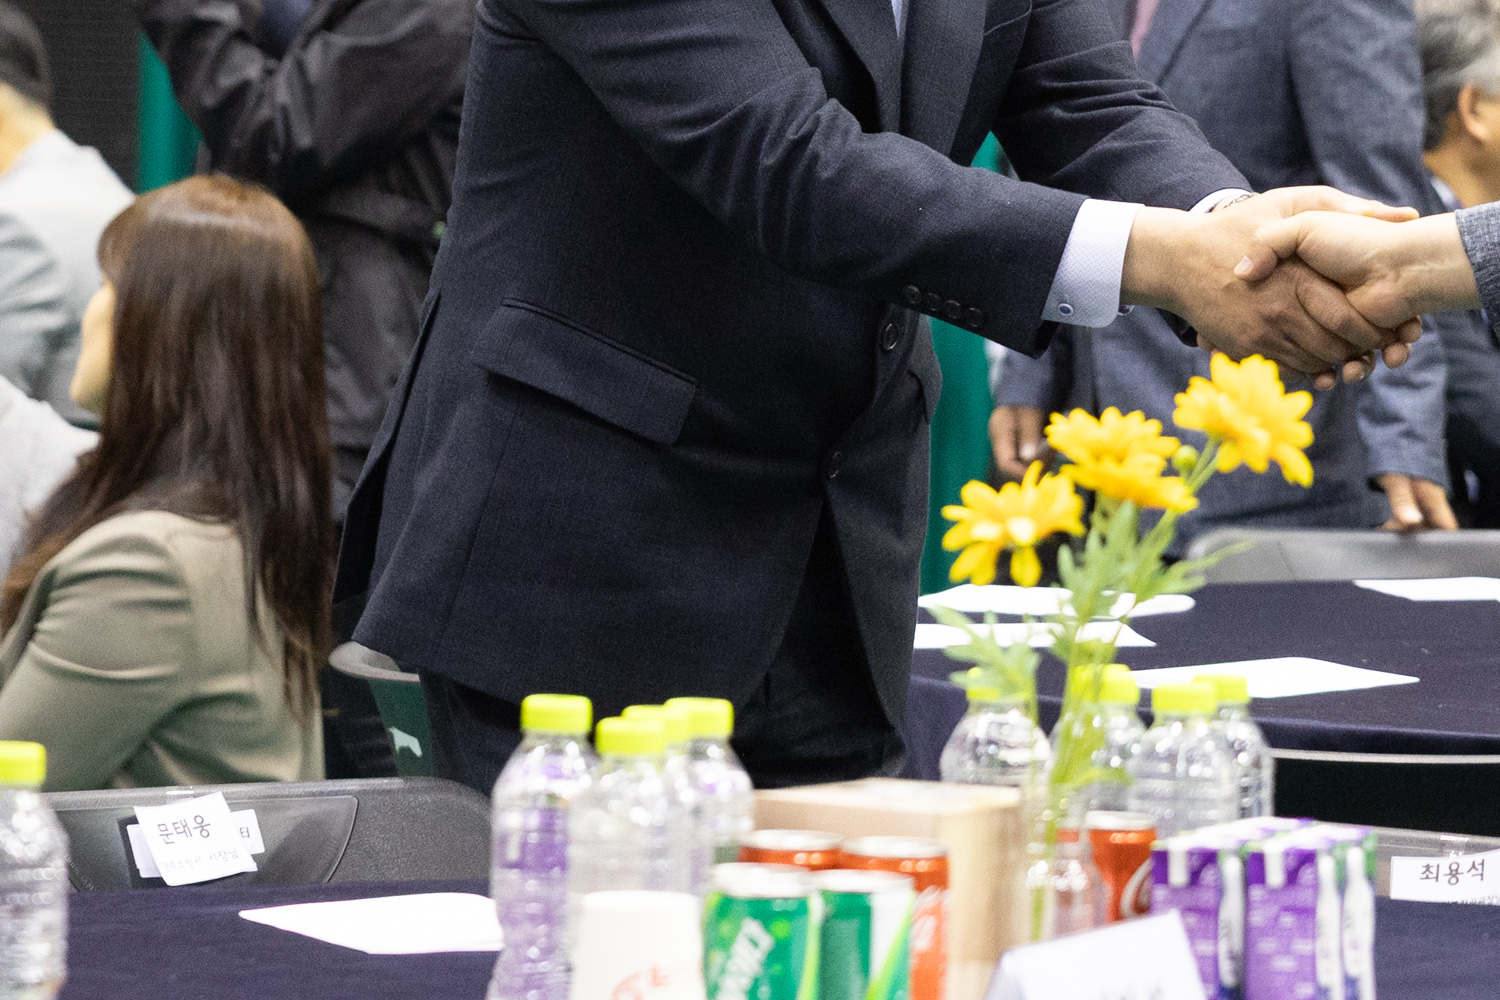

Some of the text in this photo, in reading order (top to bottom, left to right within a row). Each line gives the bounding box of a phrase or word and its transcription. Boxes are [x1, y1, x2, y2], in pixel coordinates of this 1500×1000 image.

[157, 814, 212, 845] 문태웅
[208, 847, 240, 863] 서장님
[1419, 858, 1486, 886] 최용석
